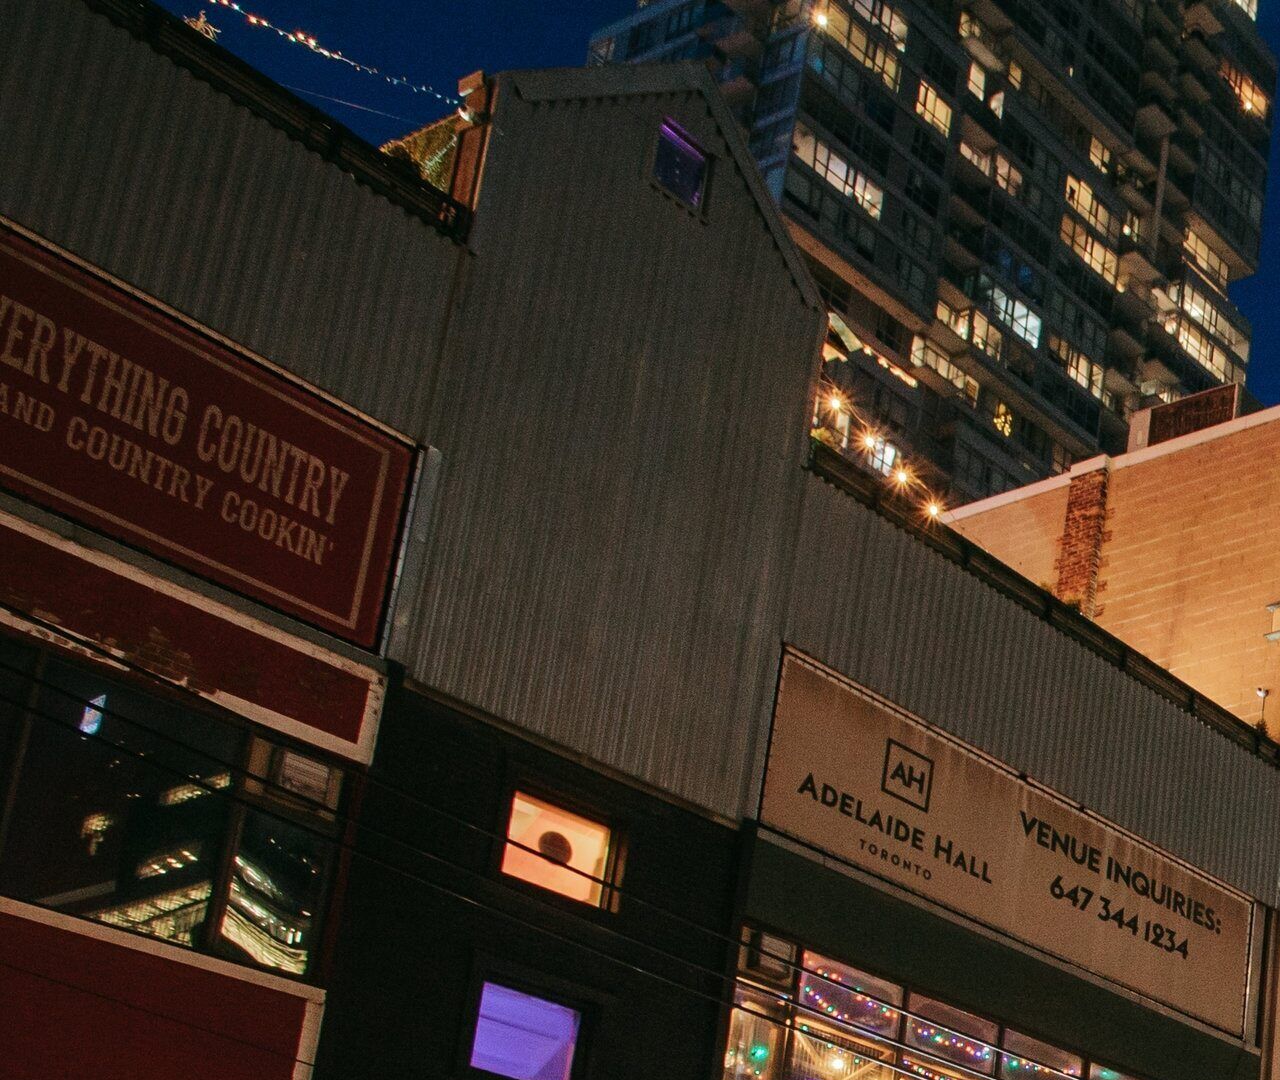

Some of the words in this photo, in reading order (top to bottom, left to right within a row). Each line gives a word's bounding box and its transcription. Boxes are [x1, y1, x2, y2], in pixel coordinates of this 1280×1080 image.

[66, 416, 215, 510] COUNTRY
[220, 490, 335, 566] COOKIN'
[197, 404, 350, 526] COUNTRY
[798, 772, 924, 850] ADELAIDE
[934, 833, 993, 885] HALL
[890, 761, 926, 795] AH
[859, 839, 933, 881] TORONTO
[1018, 810, 1102, 874] VENUE
[1105, 855, 1223, 935] INQUIRIES:
[1049, 875, 1094, 912] 647
[1097, 896, 1140, 937] 344
[1143, 921, 1191, 960] 1234
